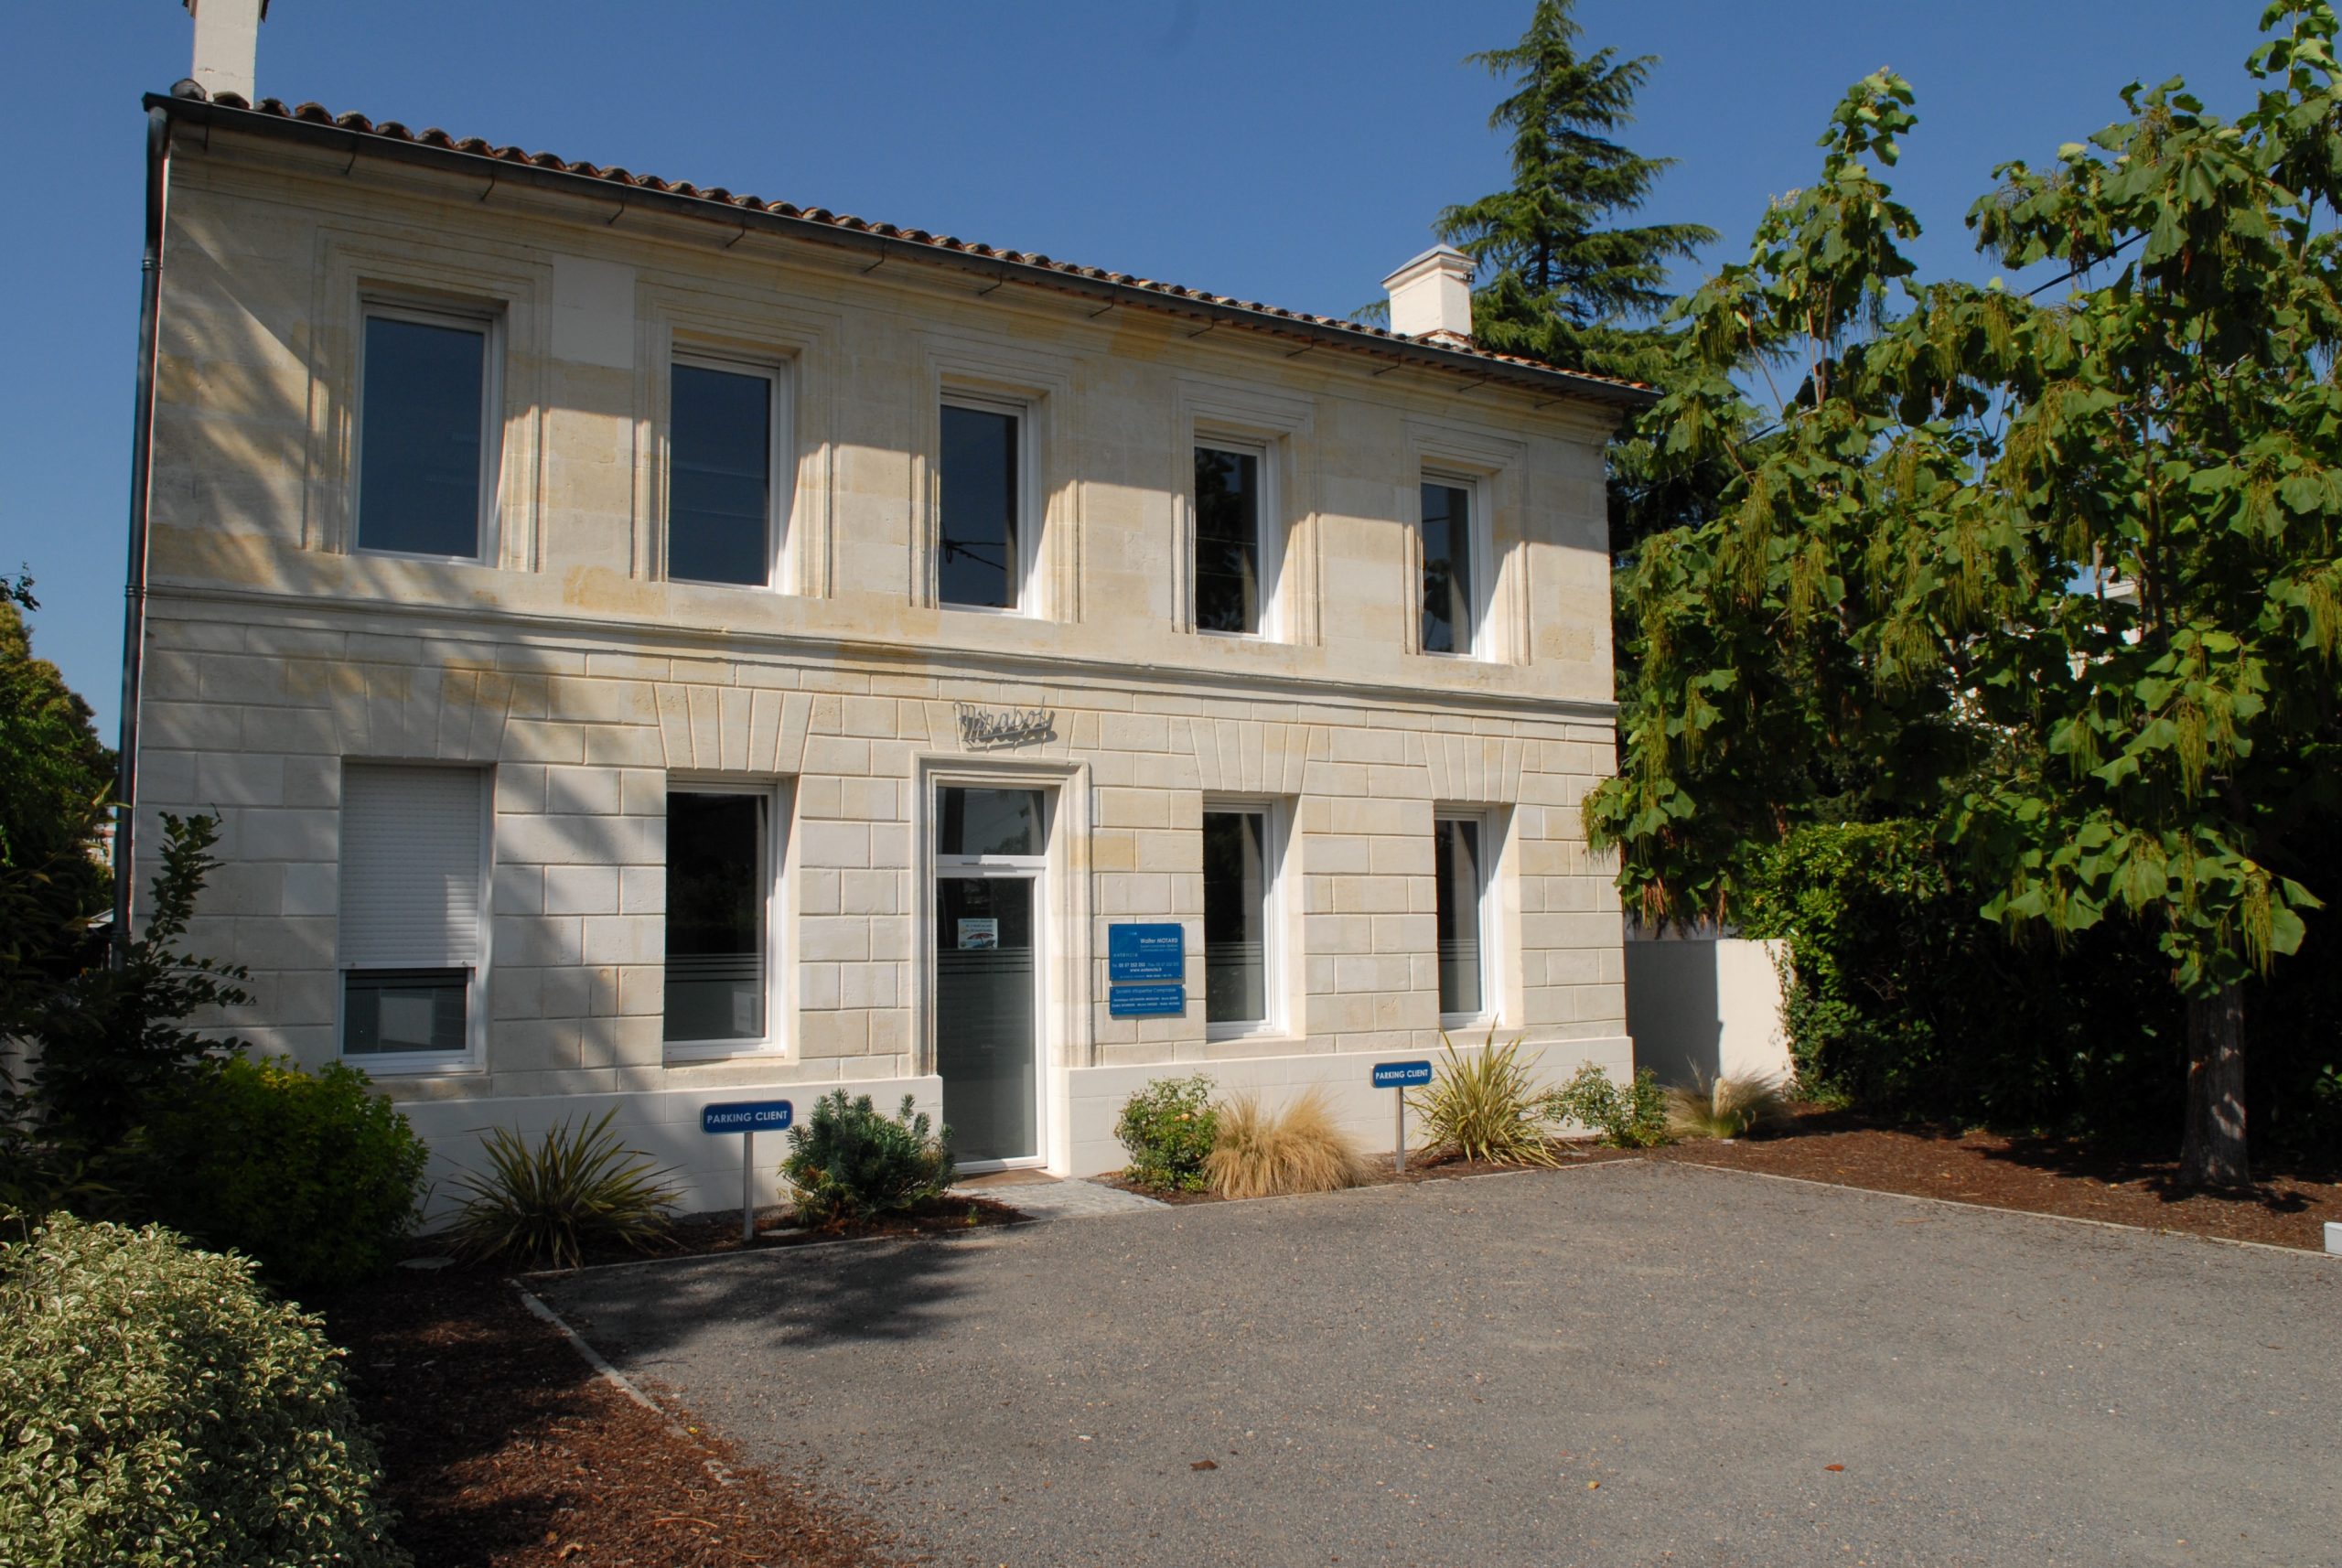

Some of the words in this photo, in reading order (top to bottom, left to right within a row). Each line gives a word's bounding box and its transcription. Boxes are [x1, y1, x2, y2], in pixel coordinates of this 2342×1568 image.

[1375, 1070, 1405, 1079] PARKING
[1406, 1069, 1428, 1078] CLIENT
[706, 1112, 752, 1123] PARKING
[756, 1111, 788, 1121] CLIENT
